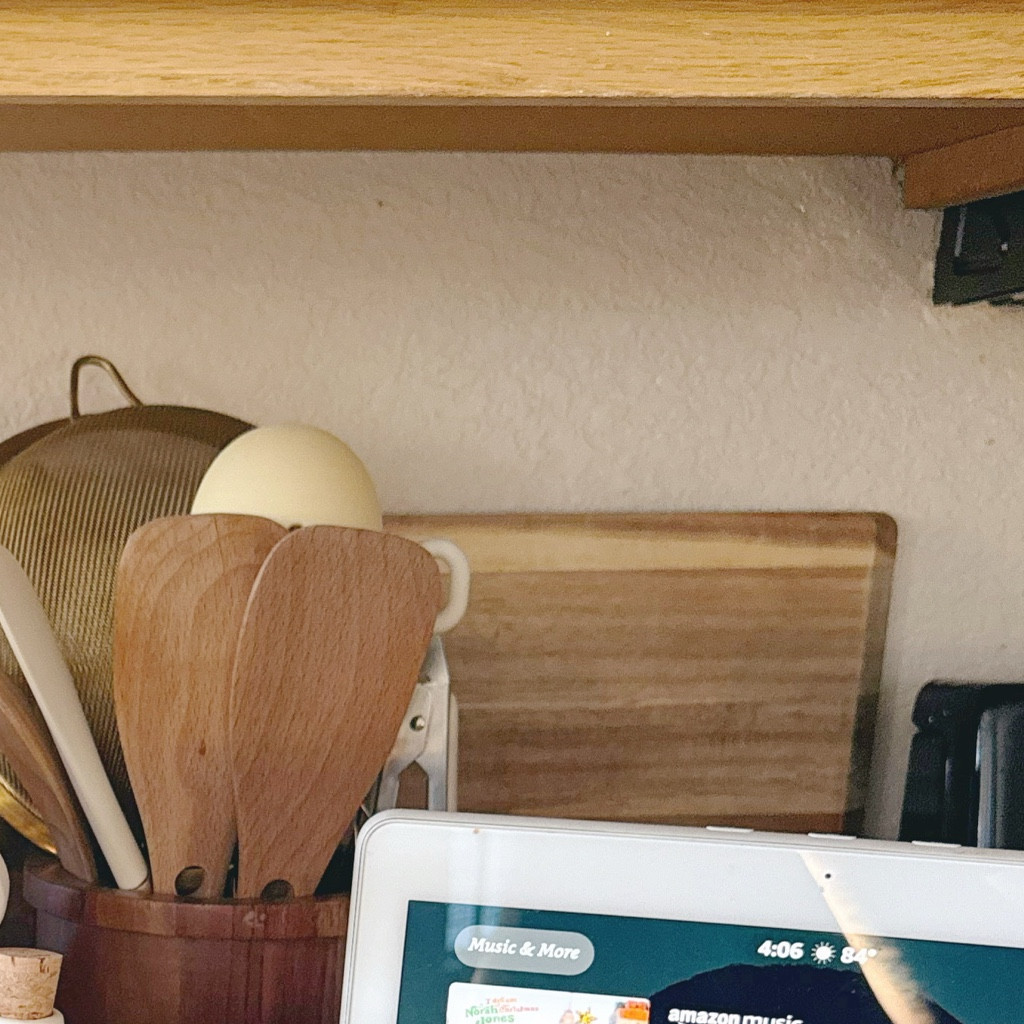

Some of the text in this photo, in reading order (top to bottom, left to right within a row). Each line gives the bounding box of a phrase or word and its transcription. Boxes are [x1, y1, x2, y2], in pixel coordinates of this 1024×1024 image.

[467, 937, 581, 960] Music & More
[757, 939, 805, 960] 4:06
[465, 1005, 498, 1018] Norah
